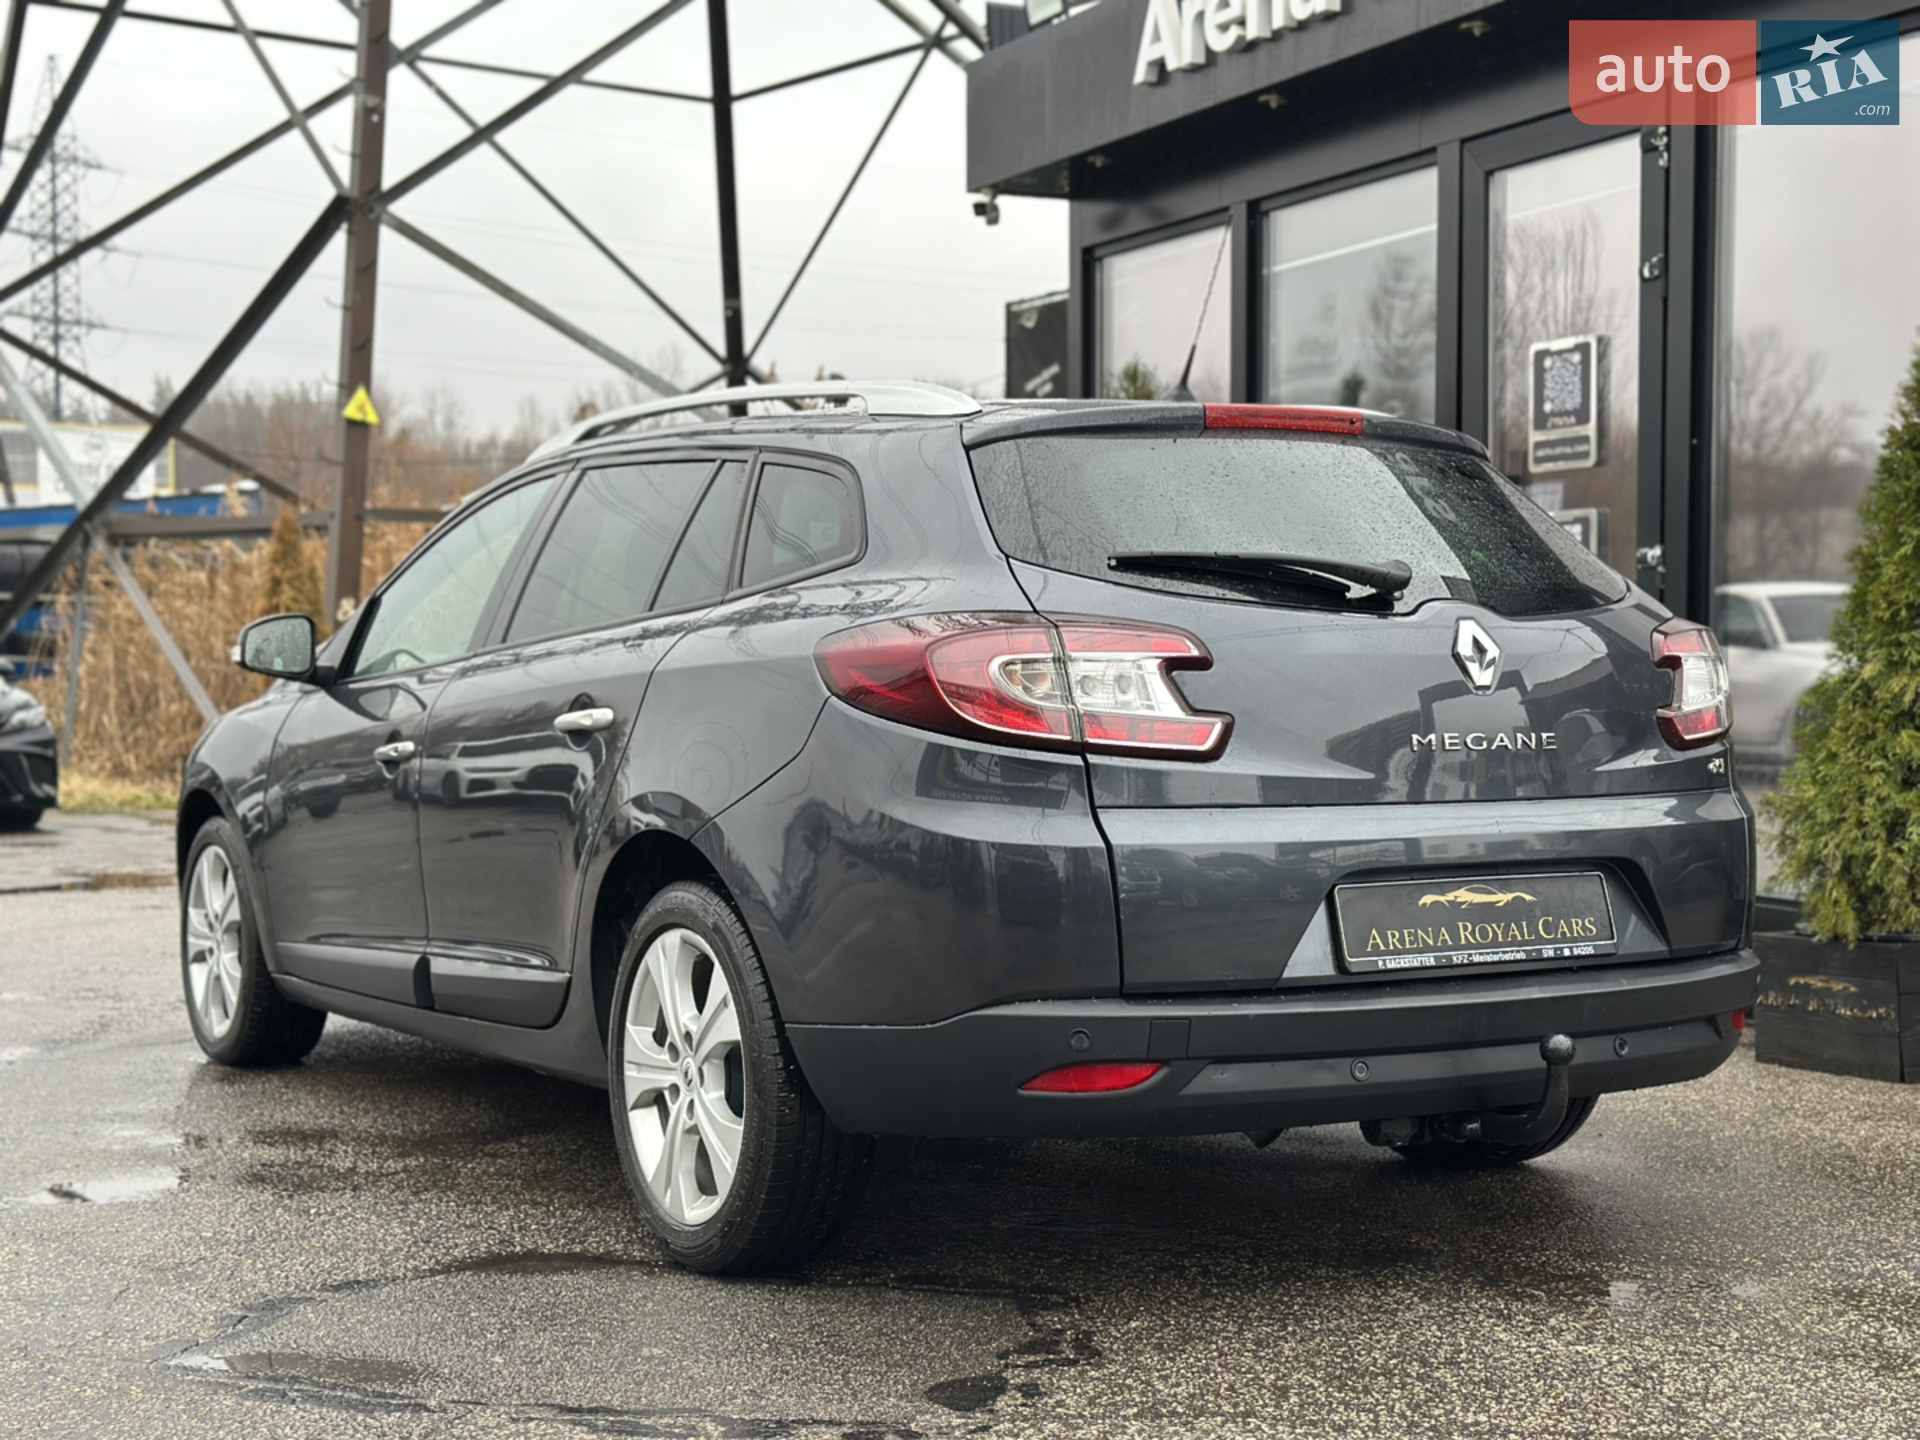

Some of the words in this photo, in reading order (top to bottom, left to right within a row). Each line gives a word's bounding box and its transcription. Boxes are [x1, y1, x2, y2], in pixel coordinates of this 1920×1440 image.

[1411, 732, 1558, 751] MEGANE
[1366, 927, 1452, 951] ARENA
[1457, 921, 1535, 945] ROYAL
[1538, 917, 1597, 939] CARS
